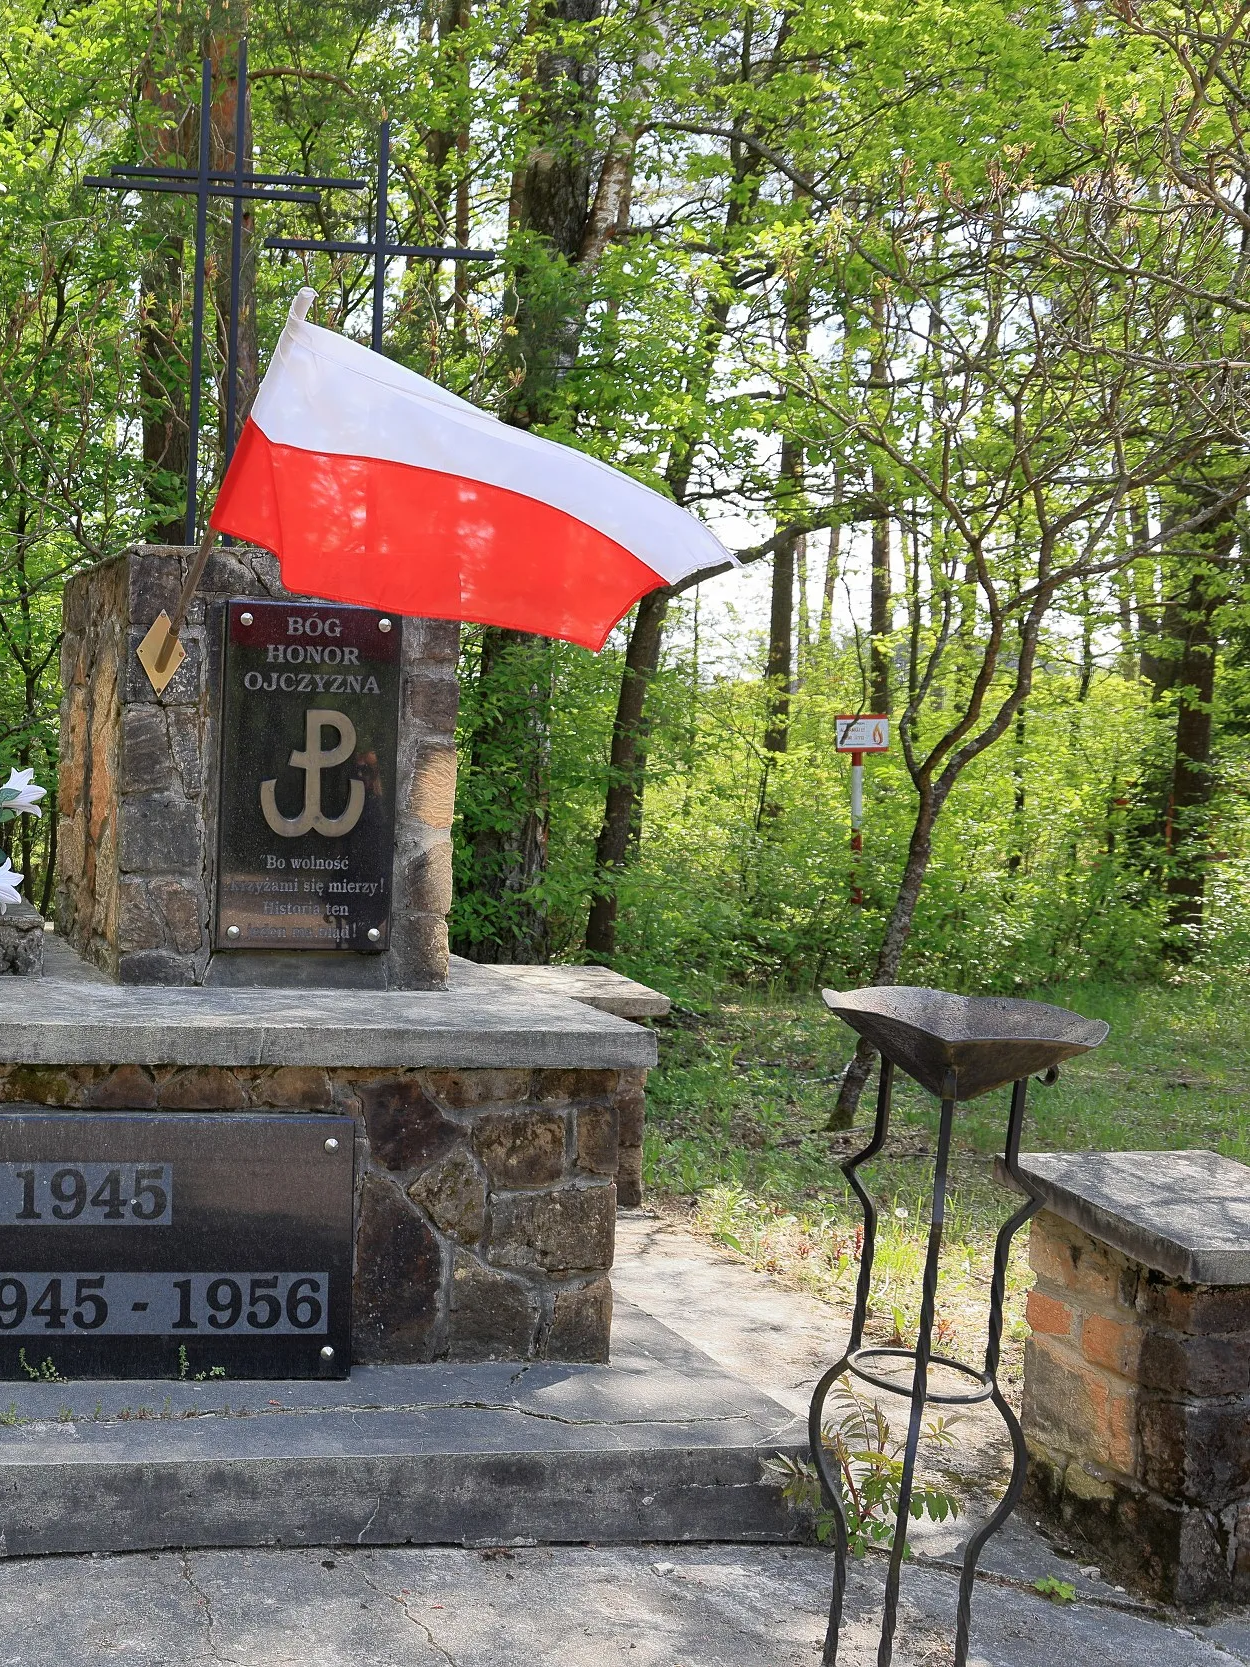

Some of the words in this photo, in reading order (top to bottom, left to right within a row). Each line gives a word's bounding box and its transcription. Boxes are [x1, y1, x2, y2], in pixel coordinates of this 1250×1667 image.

[286, 613, 343, 637] BÓG
[267, 645, 360, 665] HONOR
[244, 672, 381, 694] OJCZYZNA
[290, 856, 349, 869] wolność
[303, 878, 324, 896] się
[328, 878, 384, 896] mierzy!
[263, 901, 320, 915] Historia
[326, 903, 349, 915] ten
[15, 1168, 168, 1220] 1945
[170, 1277, 322, 1330] 1956
